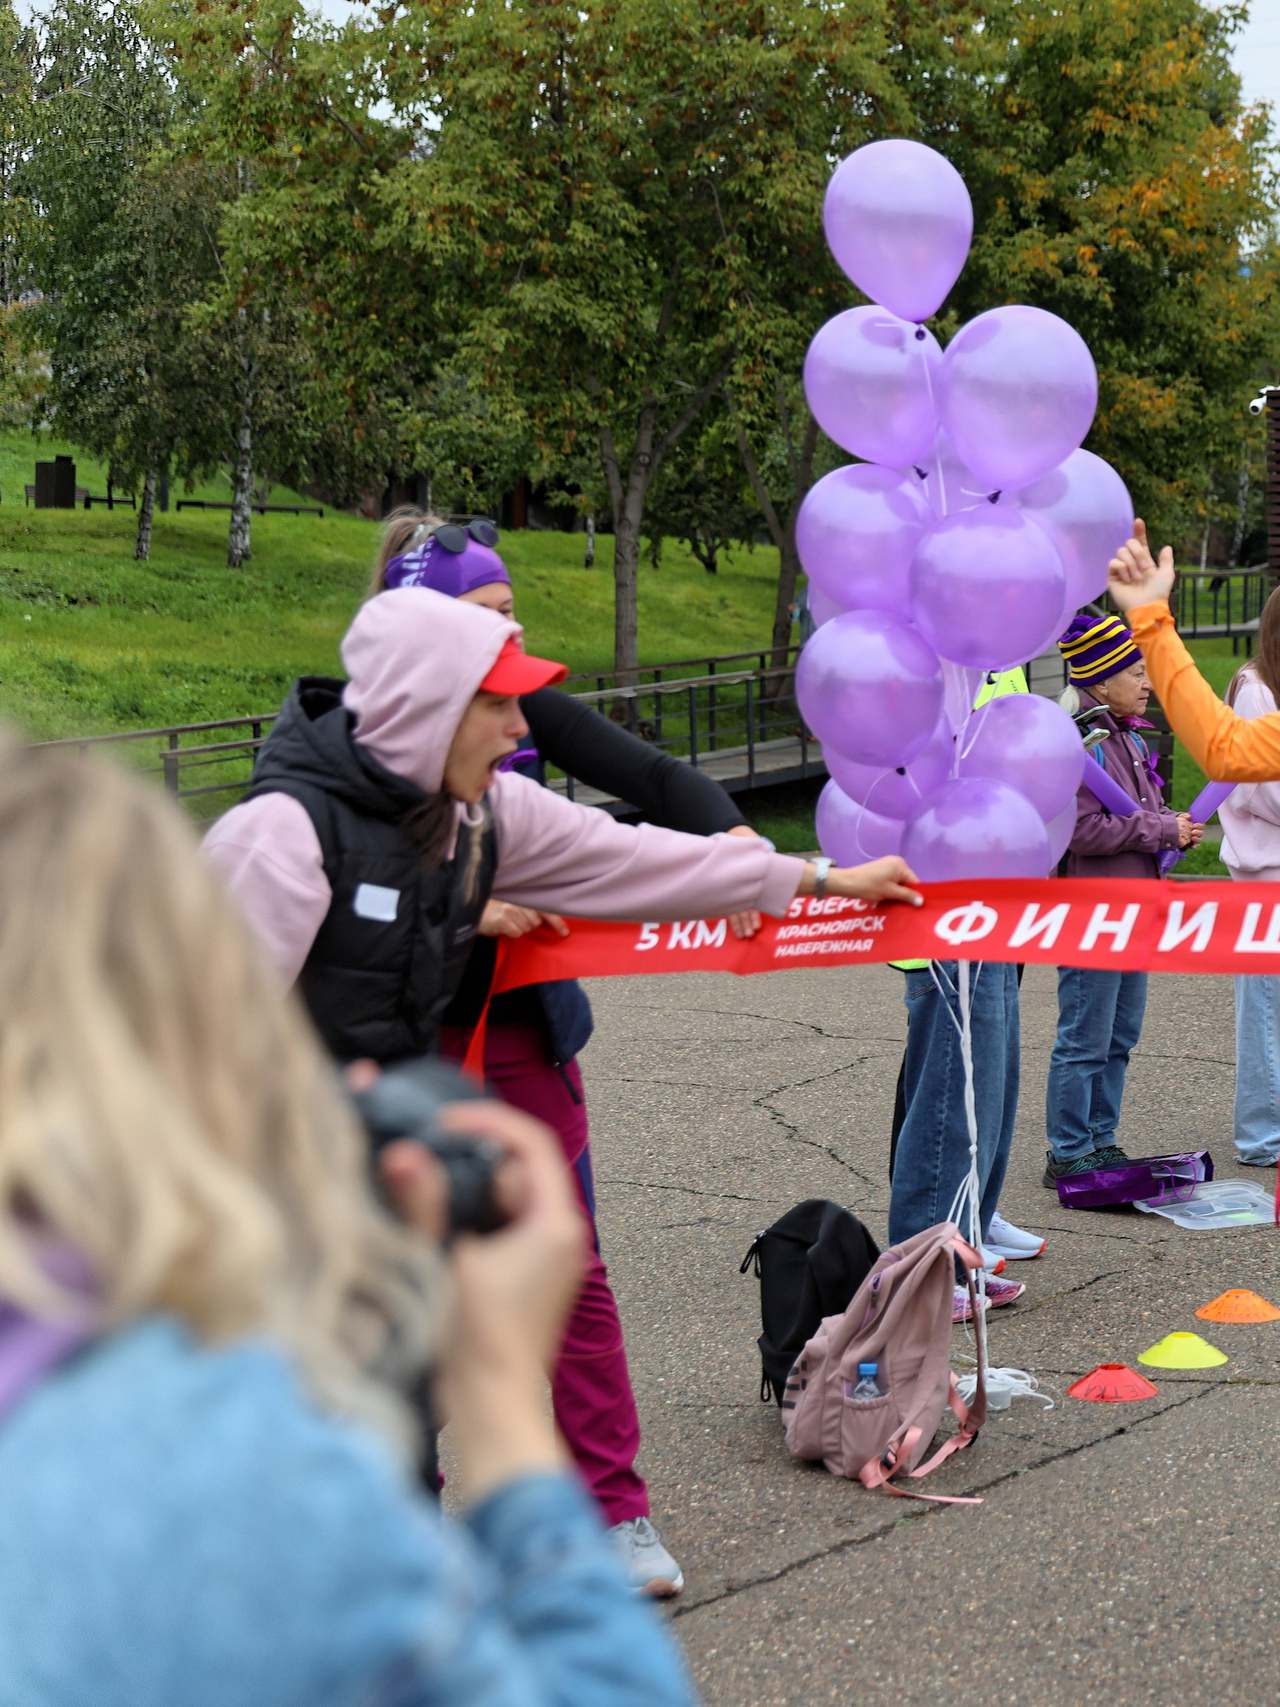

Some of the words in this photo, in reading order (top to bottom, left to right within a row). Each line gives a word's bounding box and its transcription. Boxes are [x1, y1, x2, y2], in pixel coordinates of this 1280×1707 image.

[787, 897, 806, 919] 5
[635, 921, 660, 951] 5
[667, 918, 728, 950] КМ
[775, 916, 887, 940] КРАСНОЯРСК
[774, 939, 874, 958] НАБЕРЕЖНАЯ
